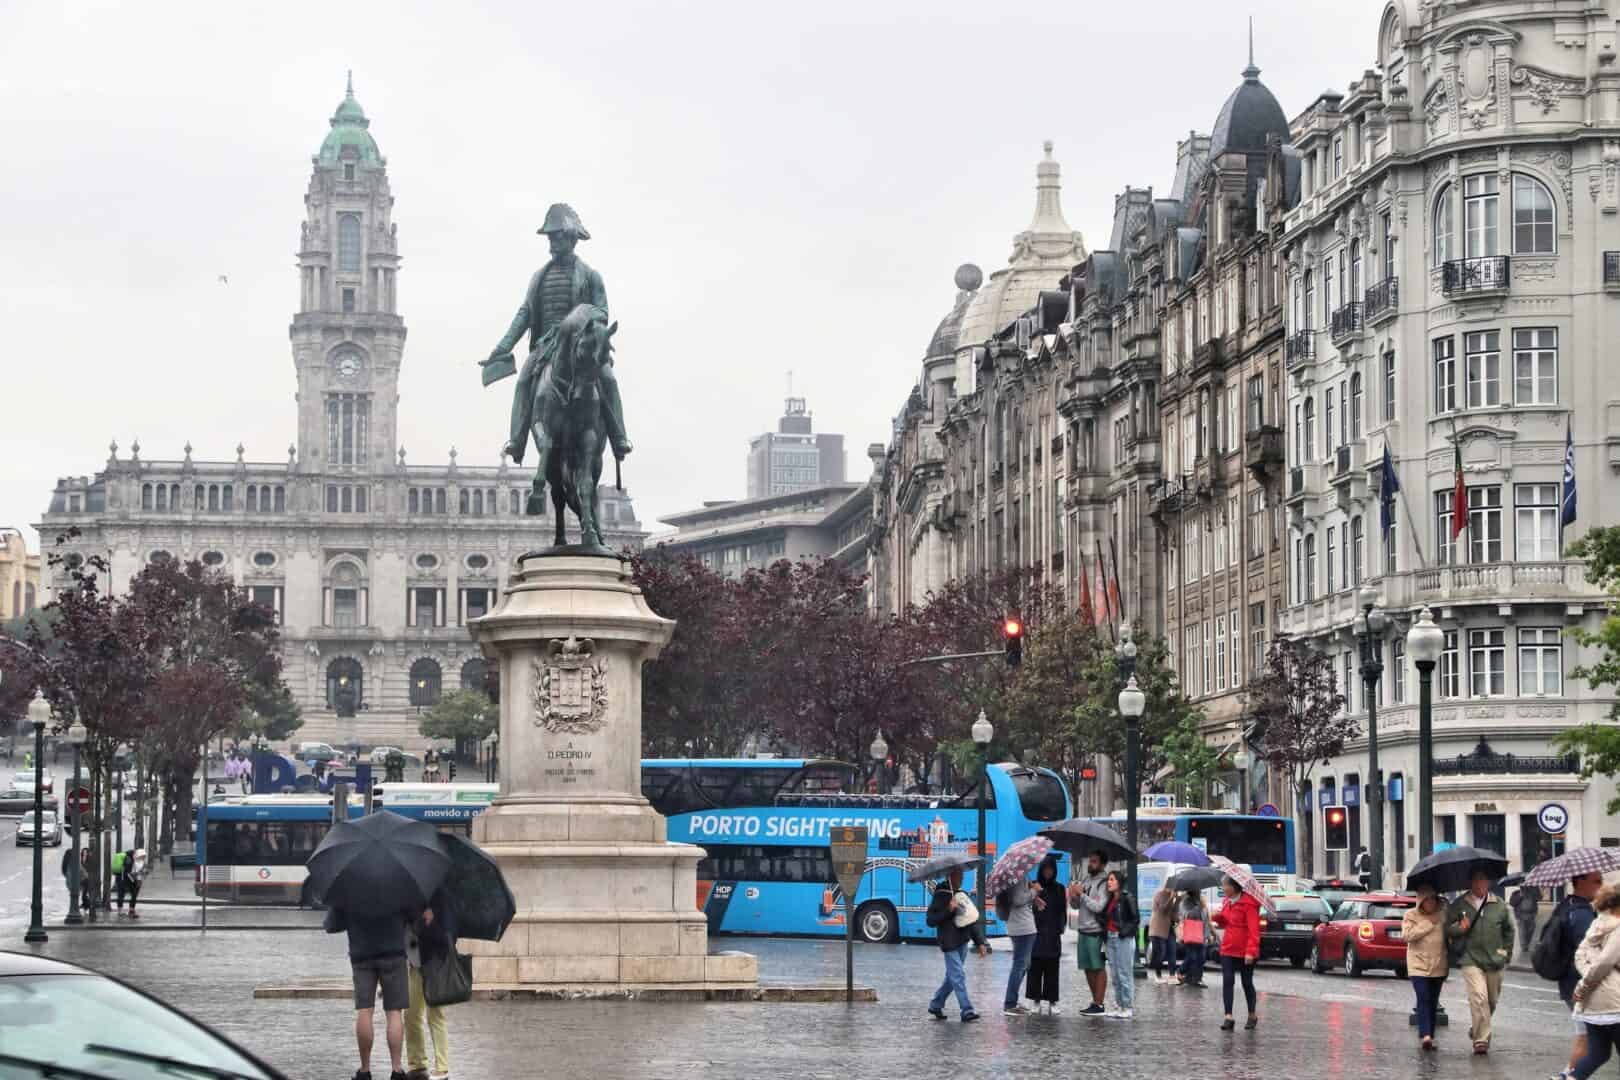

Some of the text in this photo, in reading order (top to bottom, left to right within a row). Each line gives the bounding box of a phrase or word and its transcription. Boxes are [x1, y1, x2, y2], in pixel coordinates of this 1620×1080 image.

[424, 808, 462, 817] movido
[689, 815, 761, 836] PORTO
[716, 886, 732, 894] HOP
